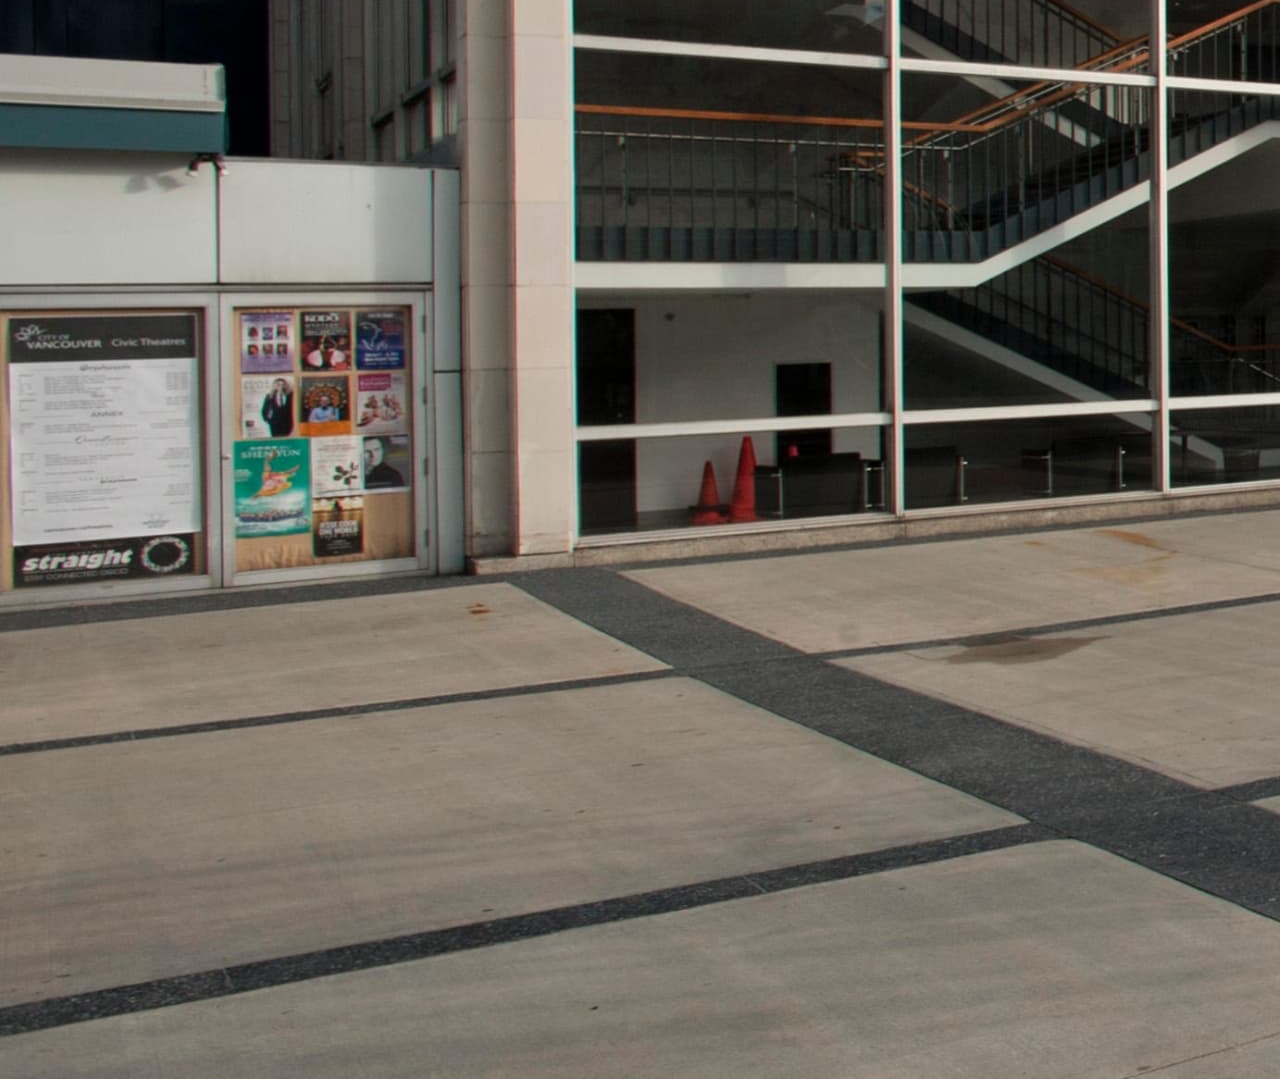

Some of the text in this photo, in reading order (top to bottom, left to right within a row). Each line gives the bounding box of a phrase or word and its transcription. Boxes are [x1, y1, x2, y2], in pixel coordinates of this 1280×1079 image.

[26, 338, 103, 349] VANCOUVER
[111, 336, 186, 348] Civic Theatres
[22, 549, 134, 572] straight
